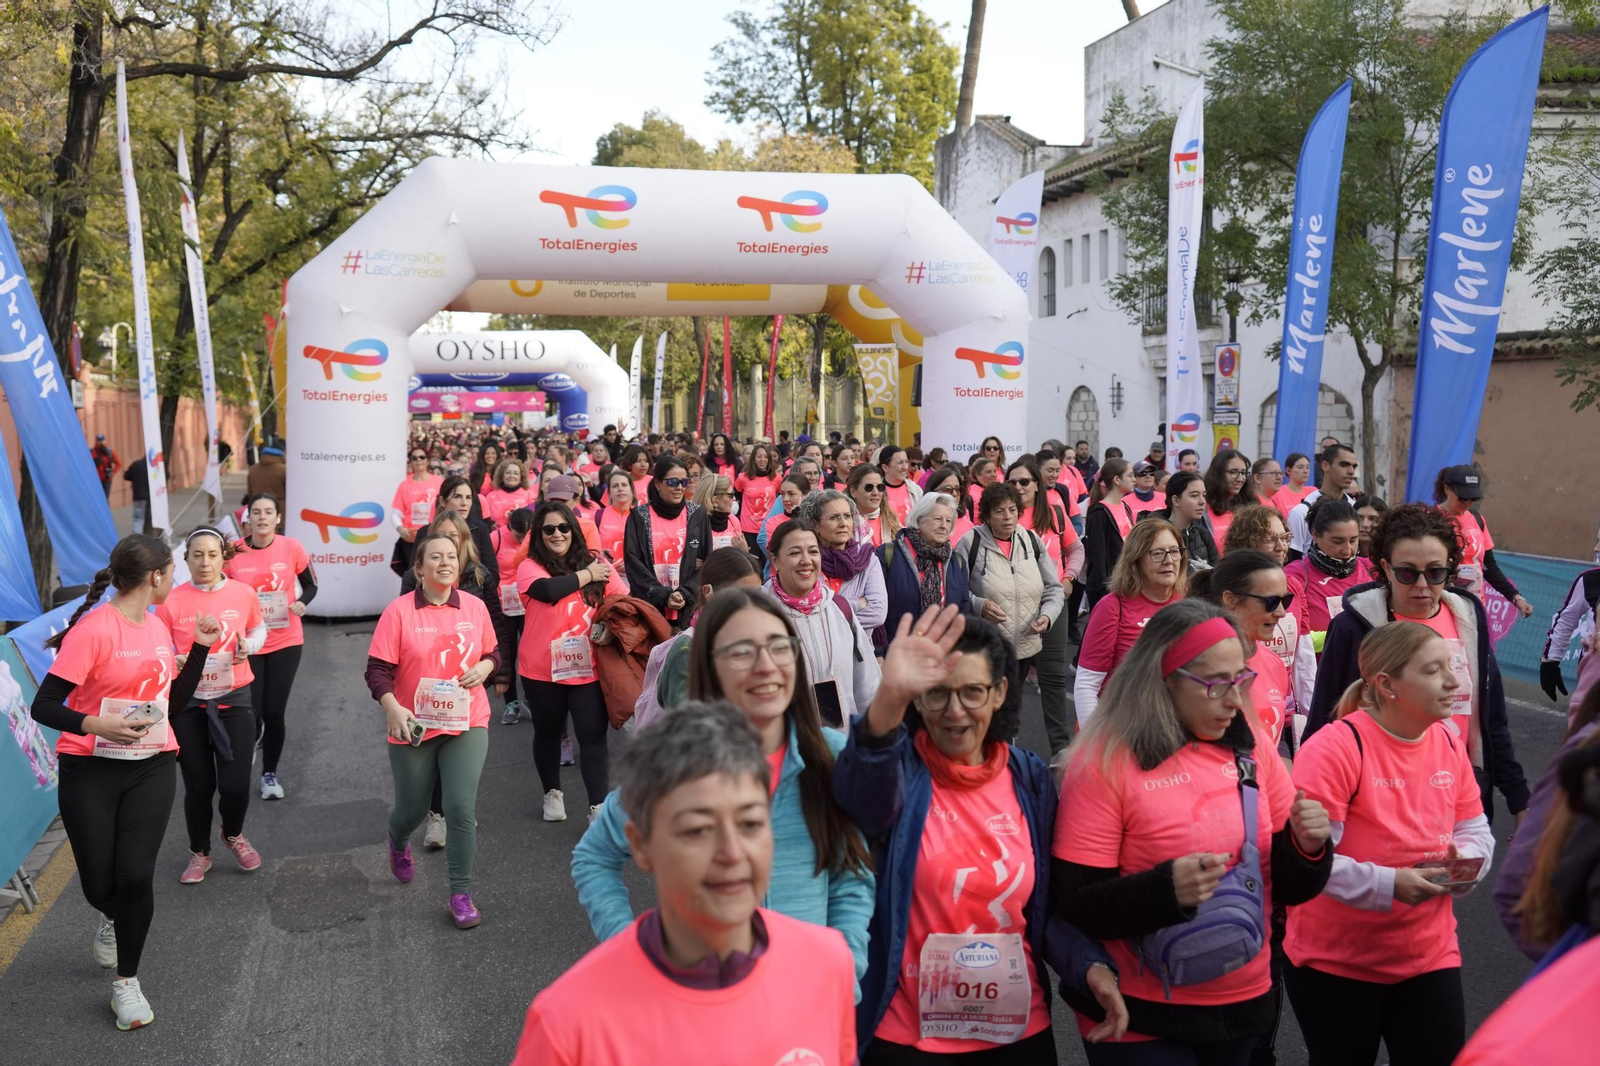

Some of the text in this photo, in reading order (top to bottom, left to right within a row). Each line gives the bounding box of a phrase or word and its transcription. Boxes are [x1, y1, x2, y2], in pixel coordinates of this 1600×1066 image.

[539, 238, 637, 253] TotalEnergies
[737, 242, 828, 256] TotalEnergies
[995, 238, 1037, 247] TotalEnergies
[1431, 163, 1504, 354] Marlene
[365, 262, 444, 278] LasCarreras
[573, 289, 636, 299] de Deportes
[1286, 214, 1327, 374] Marlene
[437, 340, 545, 360] OYSHO
[302, 389, 388, 404] TotalEnergies
[953, 387, 1024, 400] TotalEnergies
[301, 452, 386, 463] totalenergies.es
[310, 552, 384, 566] talEnergies
[115, 649, 141, 658] OYSHO
[565, 653, 583, 661] 016
[432, 700, 454, 709] 016
[1144, 772, 1191, 791] OYSHO
[1372, 777, 1405, 789] OYSHO
[957, 951, 999, 961] ASTURIANA
[955, 982, 998, 999] 016
[922, 1023, 1014, 1037] OYSHO Santander
